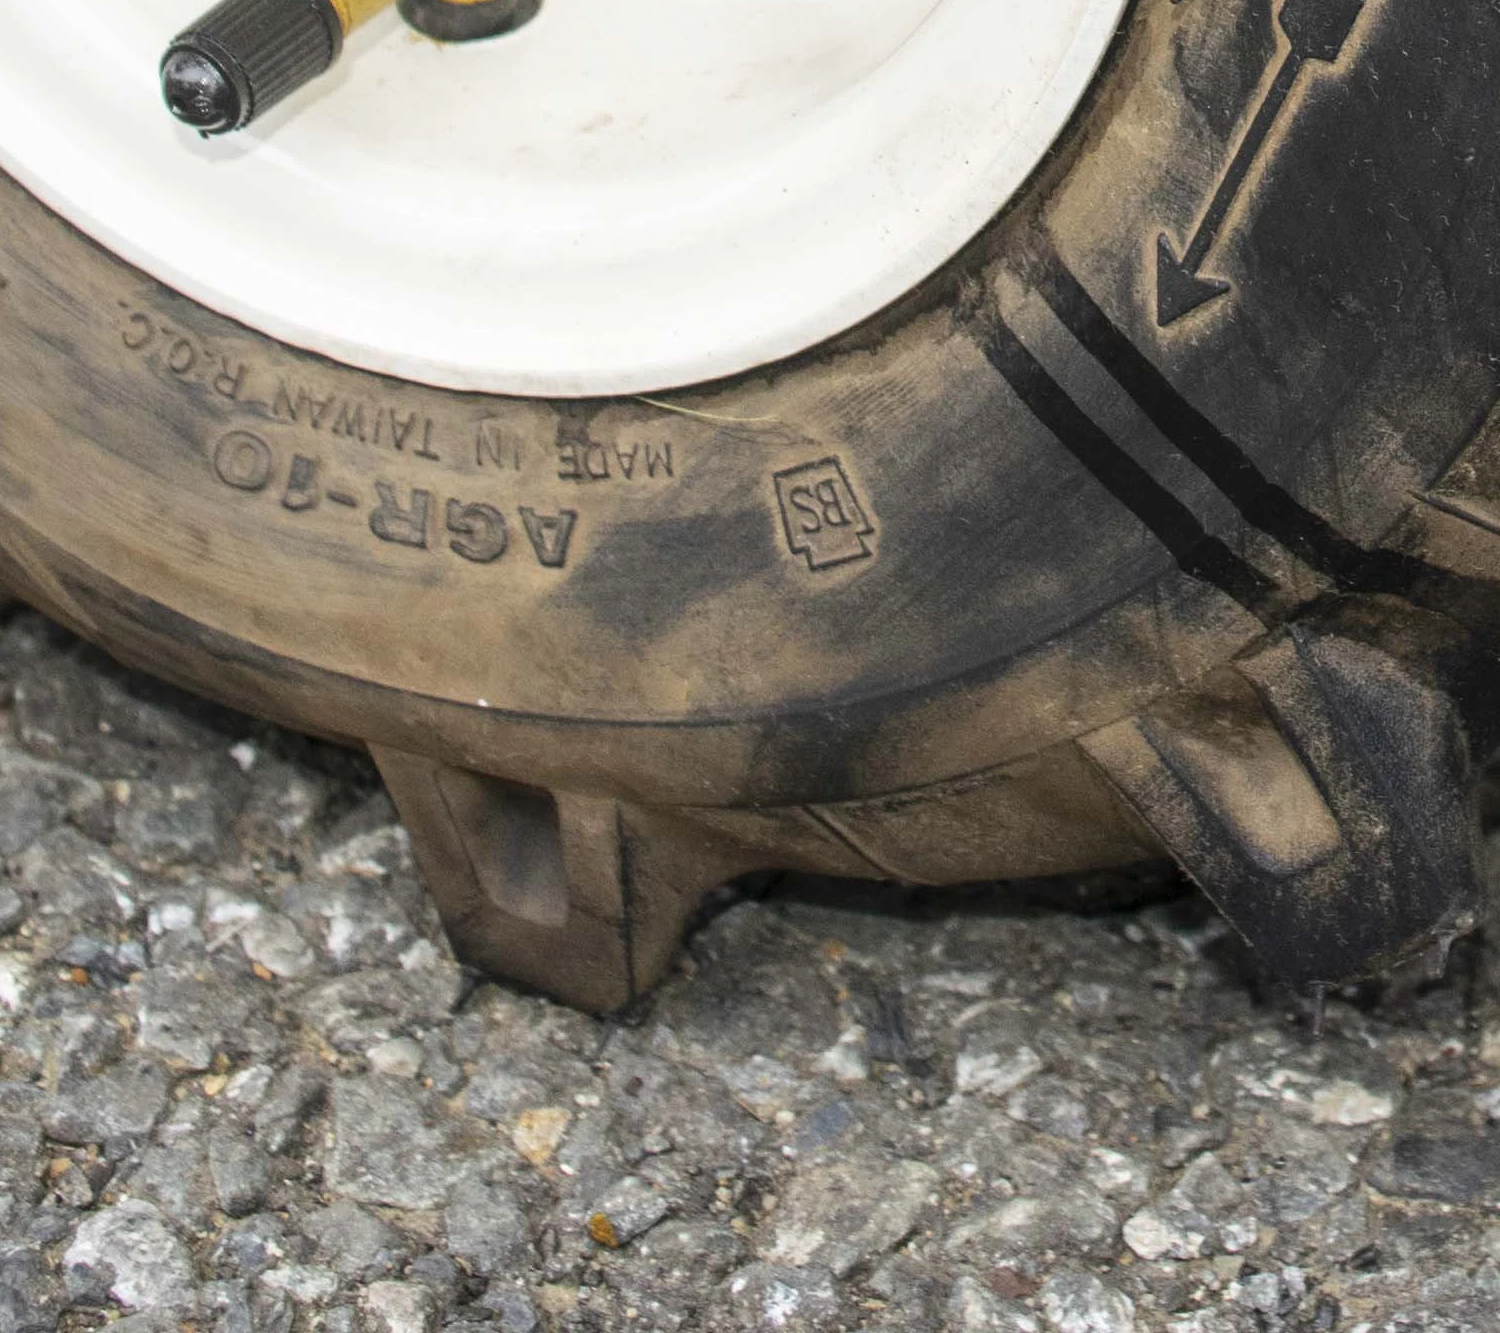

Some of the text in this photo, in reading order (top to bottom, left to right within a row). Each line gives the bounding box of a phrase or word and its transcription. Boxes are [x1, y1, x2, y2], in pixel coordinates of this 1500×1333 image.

[266, 388, 440, 461] TAIWAN
[476, 430, 523, 471] IN
[557, 438, 674, 481] MADE
[212, 429, 578, 570] AGR-10
